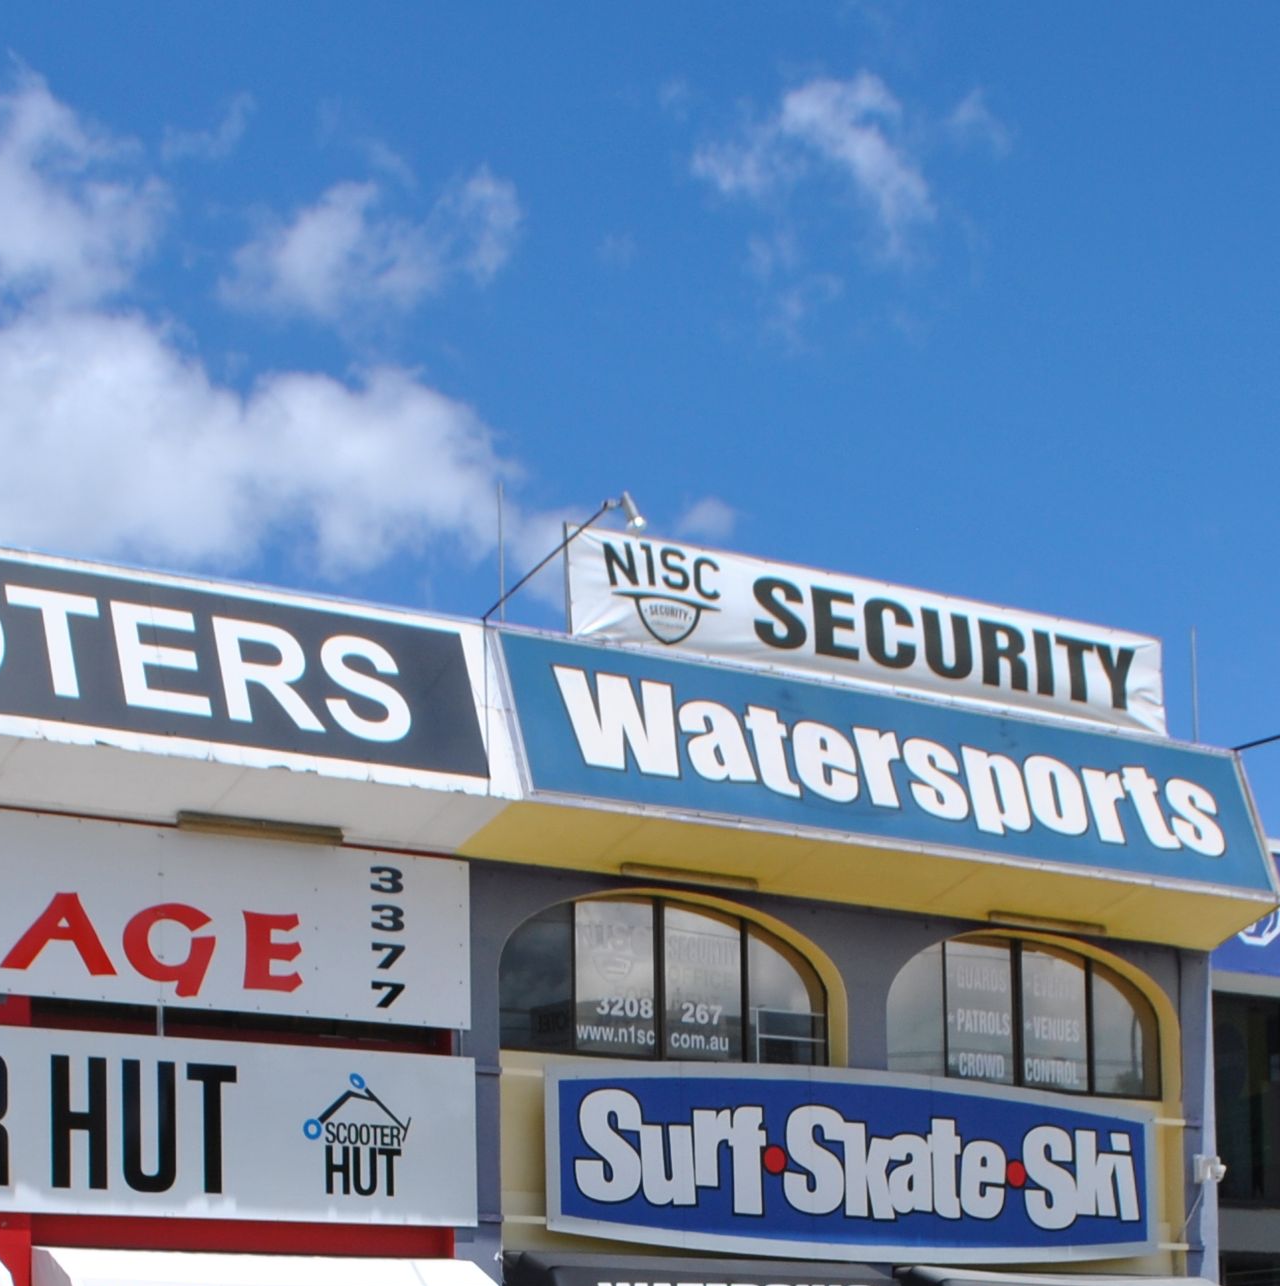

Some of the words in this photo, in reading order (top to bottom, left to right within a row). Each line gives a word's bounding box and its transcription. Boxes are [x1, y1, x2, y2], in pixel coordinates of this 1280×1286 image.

[602, 541, 720, 600] N1SC
[649, 604, 689, 621] SECURITY
[751, 577, 1136, 710] SECURITY
[552, 664, 1227, 858] Watersports
[596, 997, 654, 1019] 3208
[681, 1002, 722, 1026] 267
[957, 1008, 1010, 1036] PATROLS
[1033, 1016, 1080, 1042] VENUES
[958, 1053, 1005, 1078] CROWD
[1024, 1058, 1080, 1085] CONTROL
[50, 1054, 237, 1194] HUT
[325, 1122, 402, 1148] SCOOTER
[325, 1145, 402, 1197] HUT
[574, 1088, 765, 1217] Surf
[783, 1104, 1008, 1221] Skate
[1022, 1124, 1141, 1231] Ski
